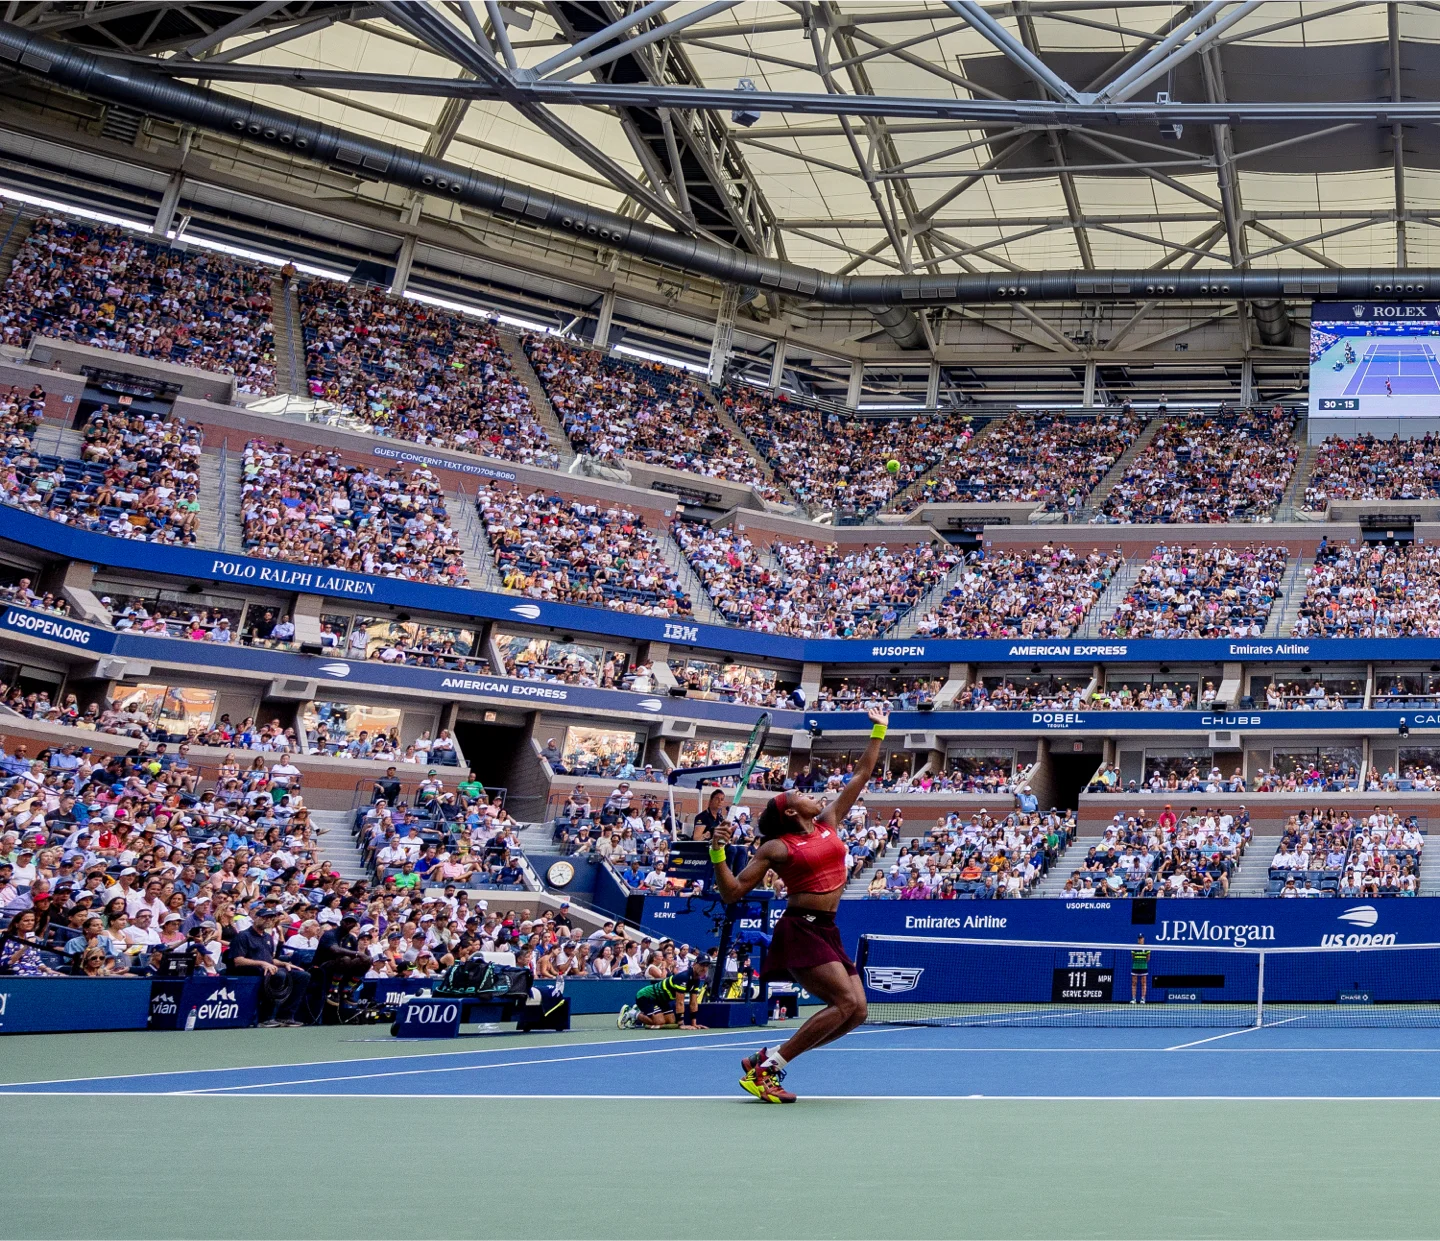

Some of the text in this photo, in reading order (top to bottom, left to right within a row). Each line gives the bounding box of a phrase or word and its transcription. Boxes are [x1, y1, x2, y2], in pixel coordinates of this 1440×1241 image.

[1372, 306, 1428, 317] ROLEX
[1323, 400, 1337, 409] 30
[1344, 400, 1355, 409] 15
[374, 446, 516, 480] GUEST CONCERN? TEXT (917)708-8080
[211, 560, 376, 595] POLO RALPH LAUREN
[7, 611, 91, 644] USOPEN.ORG
[663, 623, 699, 642] IBM
[871, 646, 925, 656] #USOPEN
[1008, 645, 1128, 656] AMERICAN EXPRESS
[1229, 644, 1310, 655] Emirates Airline
[441, 678, 568, 700] AMERICAN EXPRESS
[1201, 716, 1261, 725] CHUBB
[1065, 902, 1111, 910] USOPEN.ORG
[653, 911, 676, 919] SERVE
[905, 915, 1007, 929] Emirates Airline
[1155, 920, 1276, 948] J.P.Morgan
[1320, 933, 1396, 948] us open
[1067, 951, 1102, 968] IBM
[1068, 971, 1087, 987] 111
[1097, 974, 1112, 983] MPH
[1062, 989, 1103, 998] SERVE SPEED
[1167, 993, 1190, 1001] CHASE
[152, 1001, 177, 1014] vian
[197, 1000, 239, 1020] evian
[404, 1004, 458, 1024] POLO
